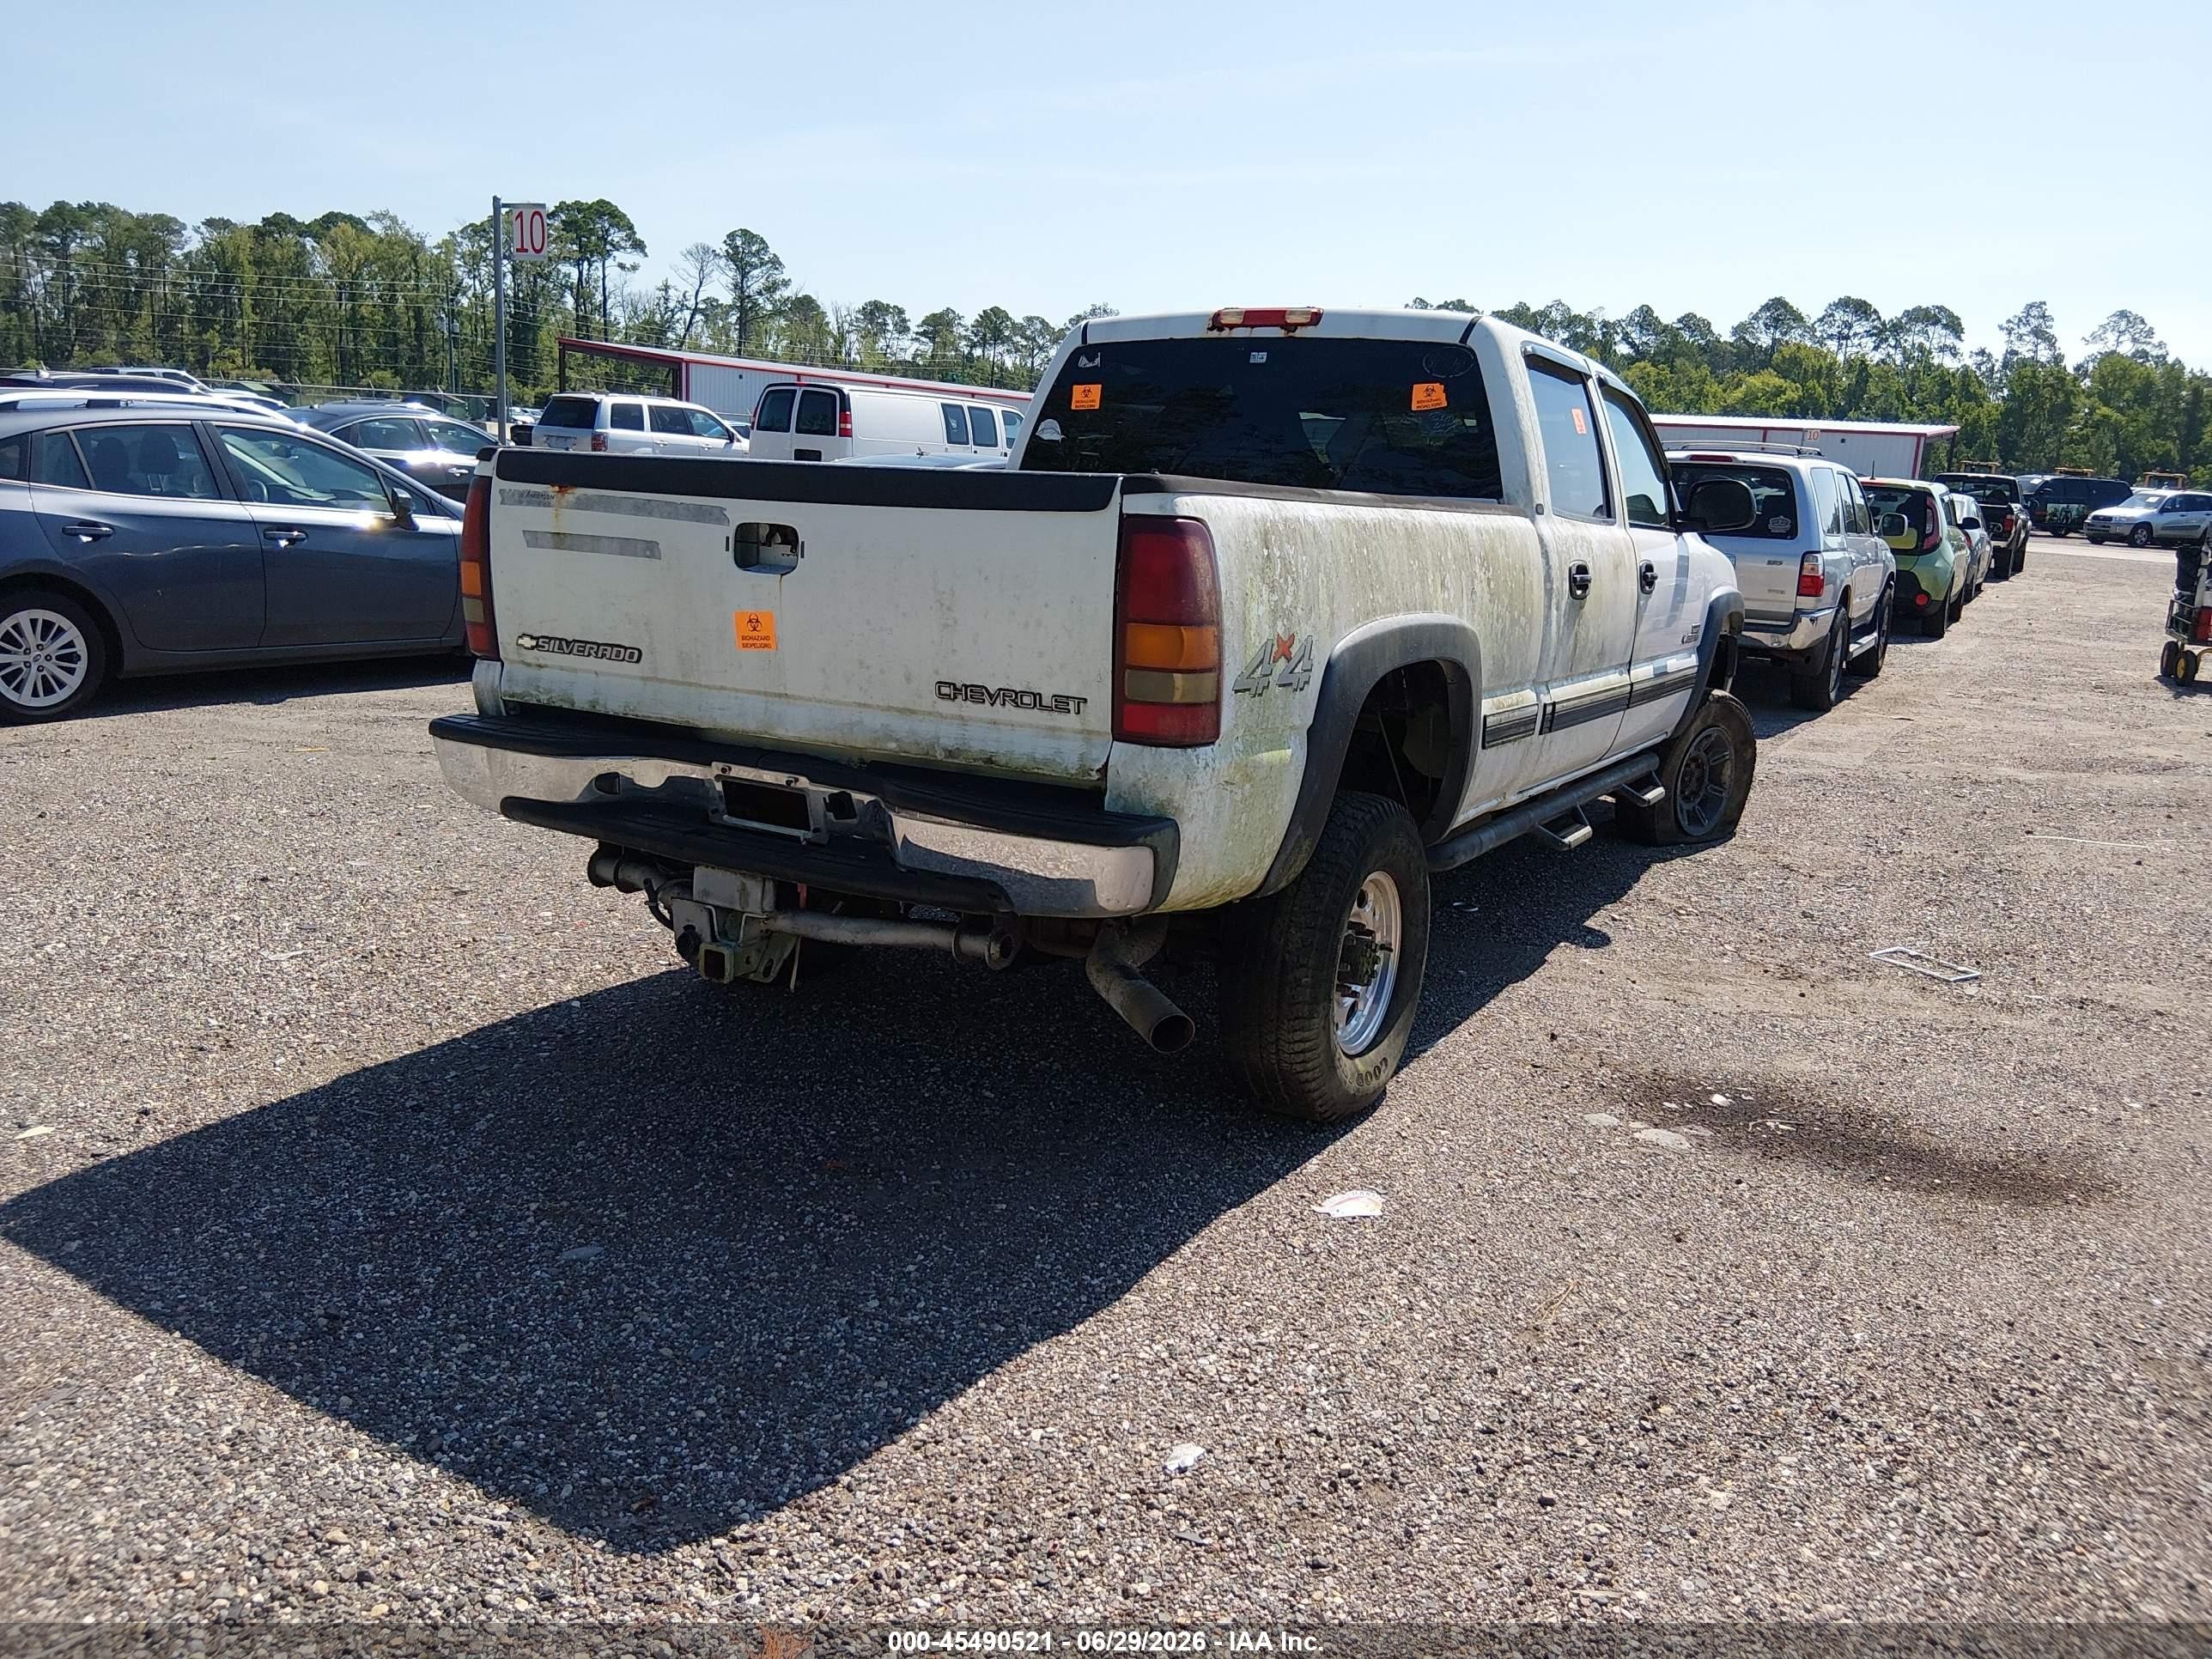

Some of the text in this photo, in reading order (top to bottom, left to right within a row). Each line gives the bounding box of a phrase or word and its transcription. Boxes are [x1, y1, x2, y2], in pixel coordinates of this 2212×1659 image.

[515, 210, 545, 254] 10
[1808, 430, 1820, 441] 10
[536, 637, 641, 663] SILVERADO
[935, 681, 1088, 715] CHEVROLET
